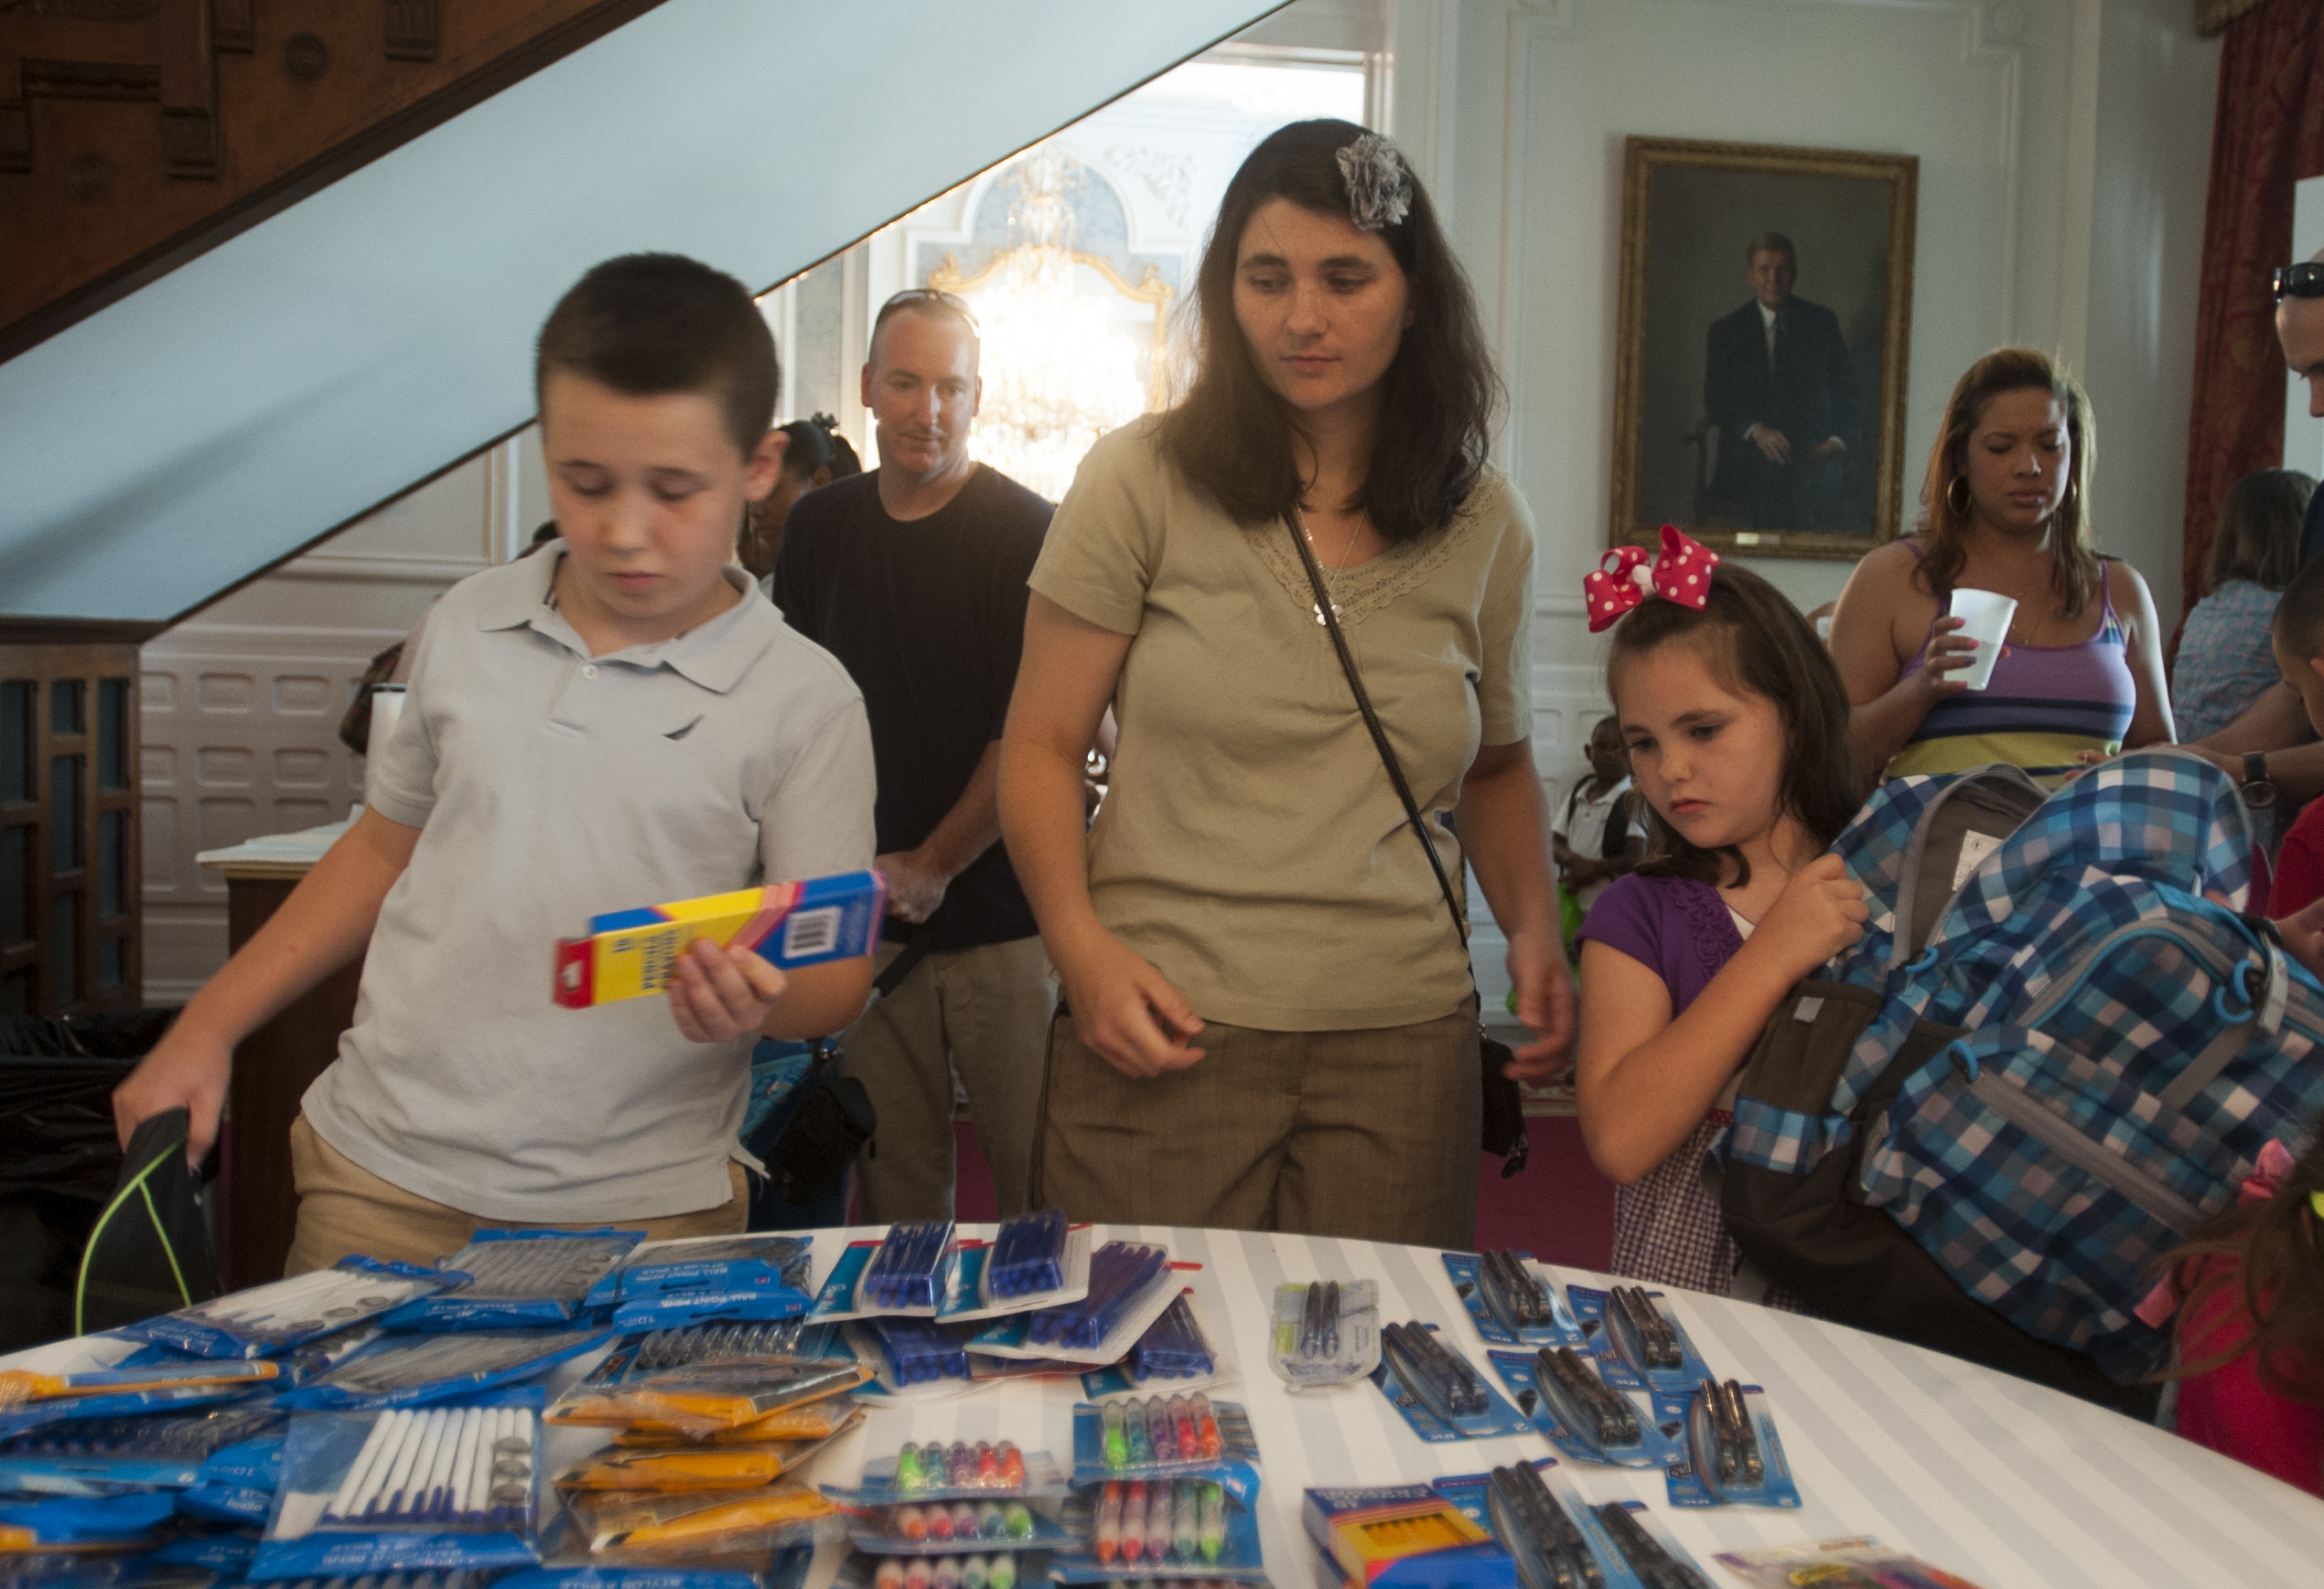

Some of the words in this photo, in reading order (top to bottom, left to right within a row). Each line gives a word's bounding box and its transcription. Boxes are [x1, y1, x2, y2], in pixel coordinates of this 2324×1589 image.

[692, 1295, 727, 1305] POINT
[730, 1293, 758, 1303] BALL
[1565, 1333, 1579, 1342] 2
[1513, 1422, 1529, 1432] 2
[1663, 1453, 1681, 1464] 2
